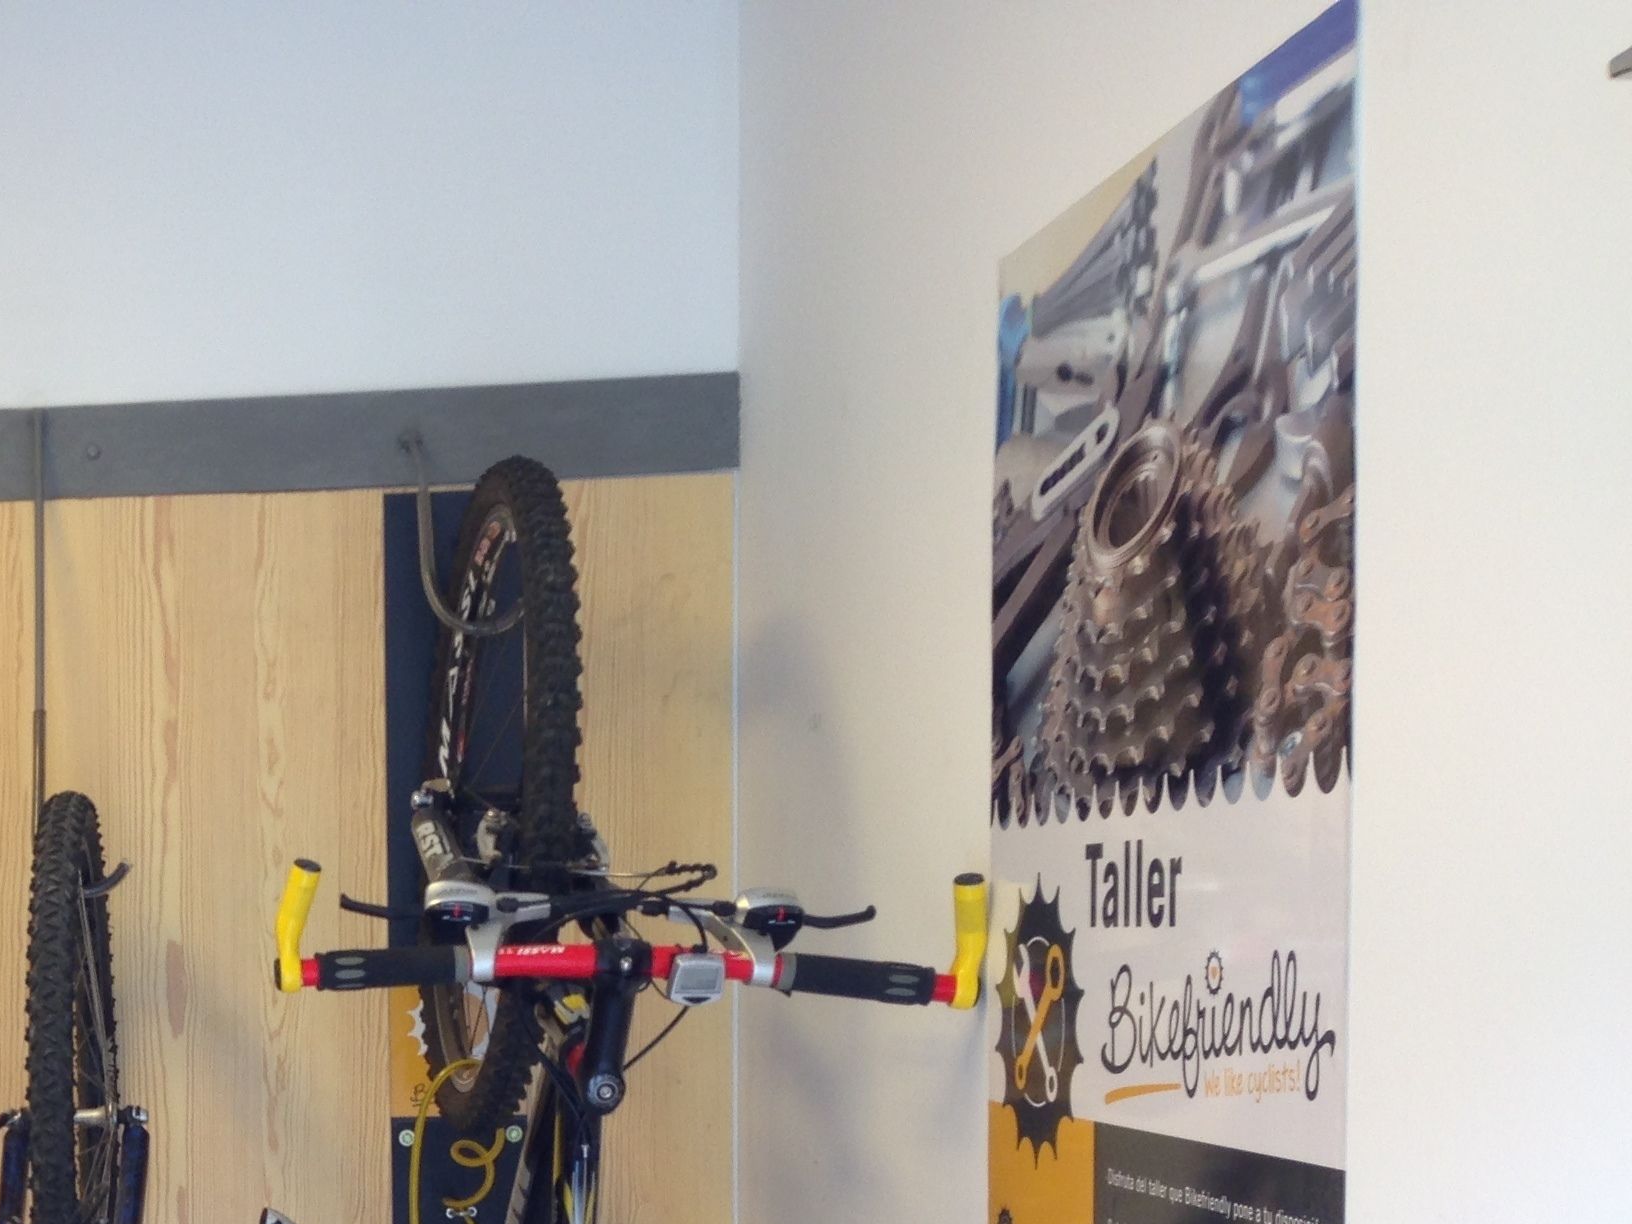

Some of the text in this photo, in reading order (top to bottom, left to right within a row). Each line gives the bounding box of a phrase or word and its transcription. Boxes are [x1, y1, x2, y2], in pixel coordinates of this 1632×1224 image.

[415, 820, 442, 858] RST
[1085, 839, 1182, 928] Taller
[1101, 950, 1336, 1100] Bikefriendly
[1148, 1179, 1167, 1198] taller
[1169, 1187, 1183, 1204] que
[1233, 1203, 1253, 1220] pone
[1255, 1208, 1261, 1222] a
[1263, 1206, 1273, 1224] tu
